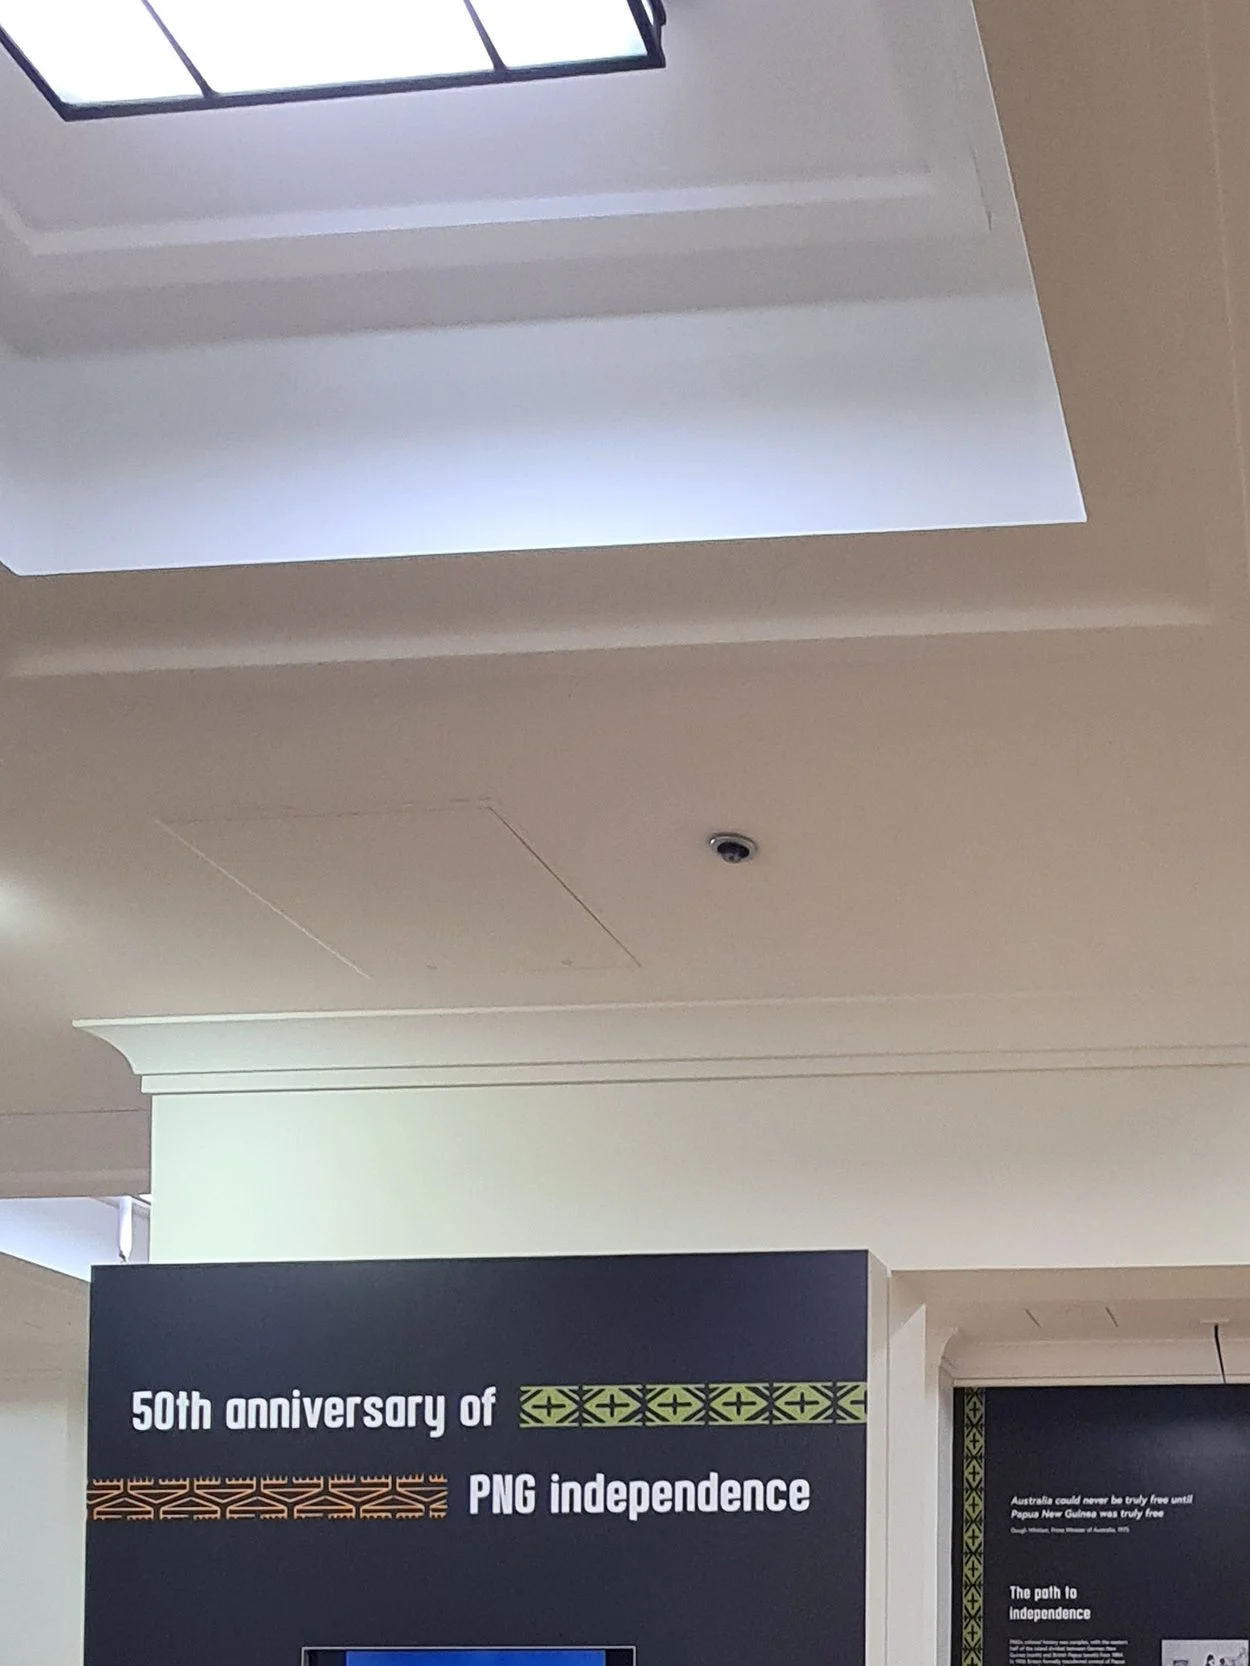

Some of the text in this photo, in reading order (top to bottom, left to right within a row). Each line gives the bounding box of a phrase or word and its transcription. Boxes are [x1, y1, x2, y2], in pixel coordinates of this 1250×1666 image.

[132, 1386, 496, 1440] 50th anniversary of
[469, 1471, 810, 1521] PNG independence
[1010, 1493, 1193, 1506] Australia could never be truly free until
[1010, 1508, 1164, 1520] Papua New Guinea was truly free
[1010, 1586, 1077, 1601] The path to
[1009, 1607, 1091, 1622] independence
